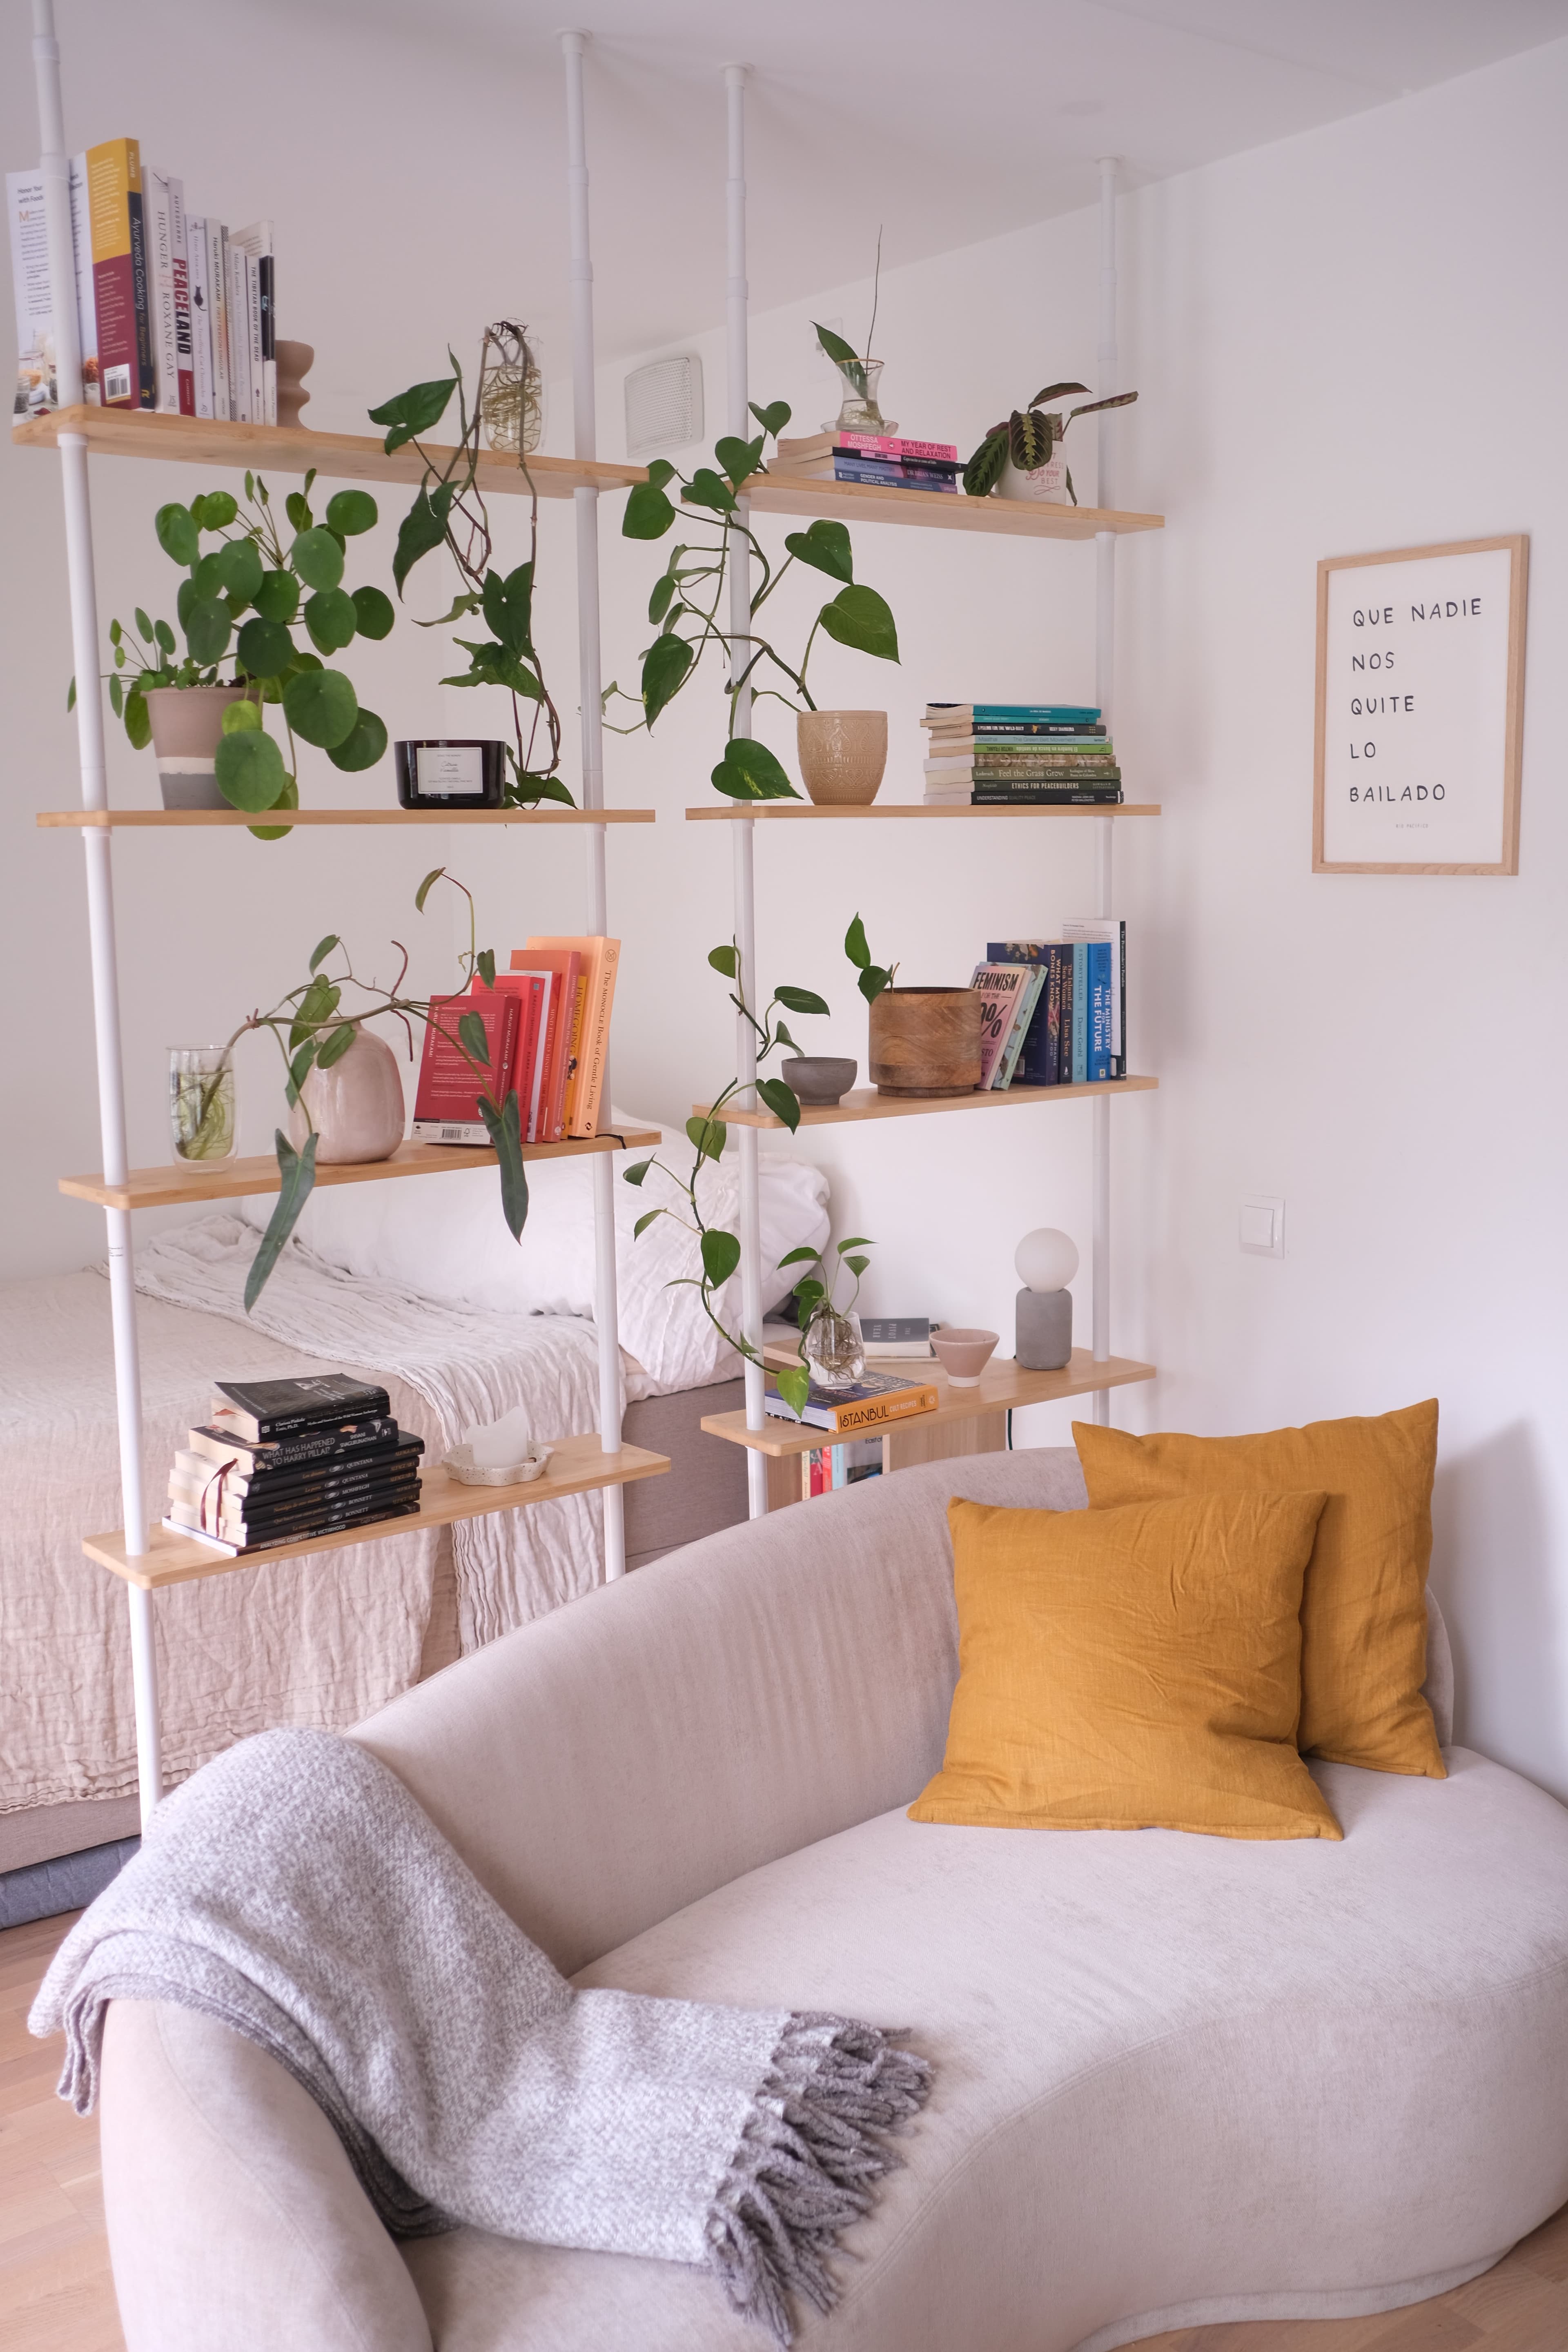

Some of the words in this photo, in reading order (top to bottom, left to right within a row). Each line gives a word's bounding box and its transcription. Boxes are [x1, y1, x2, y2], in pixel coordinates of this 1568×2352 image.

[132, 217, 143, 265] Ayurveda
[158, 211, 168, 268] HUNGER
[135, 269, 145, 310] Cooking
[172, 257, 192, 355] PEACELAND
[163, 292, 173, 348] ROXANE
[165, 353, 174, 379] GAY
[848, 441, 881, 451] MOSHFEGH
[851, 434, 878, 443] OTTESSA
[911, 441, 927, 450] YEAR
[915, 449, 951, 459] RELAXATION
[1353, 607, 1394, 627] QUE
[1411, 598, 1482, 622] NADIE
[1352, 651, 1395, 672] NOS
[1351, 695, 1415, 715] QUITE
[1350, 742, 1376, 759] LO
[998, 769, 1011, 777] Feel
[1013, 769, 1024, 777] the
[1350, 784, 1446, 802] BAILADO
[603, 970, 612, 986] The
[973, 971, 1020, 991] FEMINISM
[1056, 987, 1060, 1000] MY
[1094, 985, 1102, 1008] THE
[599, 987, 608, 1024] MONOCLE
[570, 987, 583, 1054] HOMEGOING
[596, 1026, 605, 1046] Book
[1094, 1010, 1102, 1052] FUTURE
[428, 1027, 437, 1057] MURAKAMI
[594, 1047, 602, 1056] of
[590, 1057, 600, 1083] Gentle
[587, 1085, 597, 1110] Living
[873, 1325, 882, 1338] YEAR
[888, 1323, 897, 1339] PIVOT
[840, 1405, 889, 1428] ISTANBUL
[889, 1404, 899, 1413] CULT
[900, 1400, 917, 1410] RECIPES
[262, 1448, 284, 1459] WHAT
[285, 1445, 300, 1454] HAS
[301, 1437, 335, 1451] HAPPENED
[272, 1457, 282, 1466] TO
[283, 1451, 307, 1463] HARRY
[347, 1458, 373, 1469] QUINTANA
[342, 1473, 368, 1484] QUINTANA
[342, 1483, 370, 1495] MOSHFEGH
[348, 1494, 373, 1505] BONNETT
[345, 1507, 369, 1517] BONNETT
[260, 1538, 286, 1549] ANALYZING
[286, 1531, 317, 1543] COMPETITIVE
[317, 1524, 346, 1537] VICTIMHOOD
